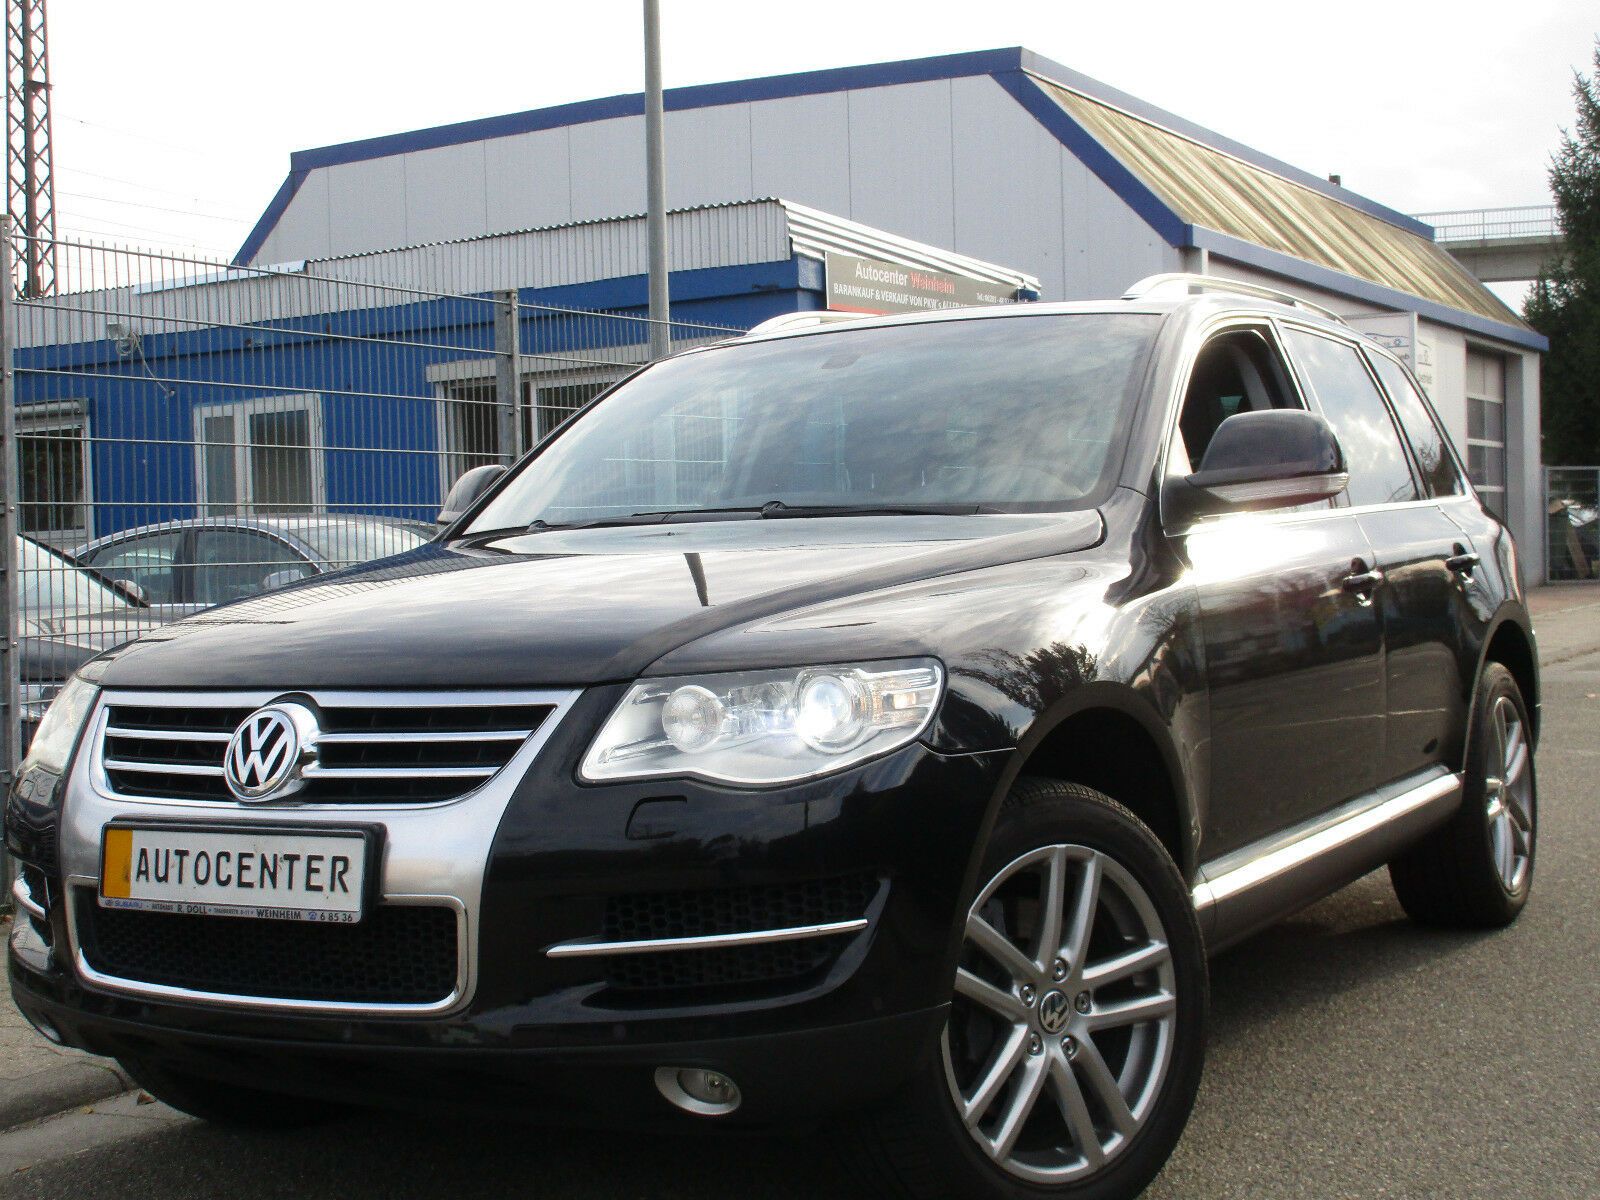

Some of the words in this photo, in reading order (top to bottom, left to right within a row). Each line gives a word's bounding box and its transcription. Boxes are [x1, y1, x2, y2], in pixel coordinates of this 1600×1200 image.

[855, 262, 908, 286] Autocenter
[910, 272, 955, 295] Weinheim
[833, 282, 875, 299] BARANKAUF
[875, 289, 881, 300] &
[881, 290, 909, 304] VERKAUF
[909, 295, 923, 307] VON
[136, 847, 350, 893] AUTOCENTER
[186, 904, 207, 914] DOLL
[256, 909, 301, 920] WEINHEIM
[320, 912, 326, 921] 6
[328, 912, 339, 921] 85
[342, 913, 352, 922] 36
